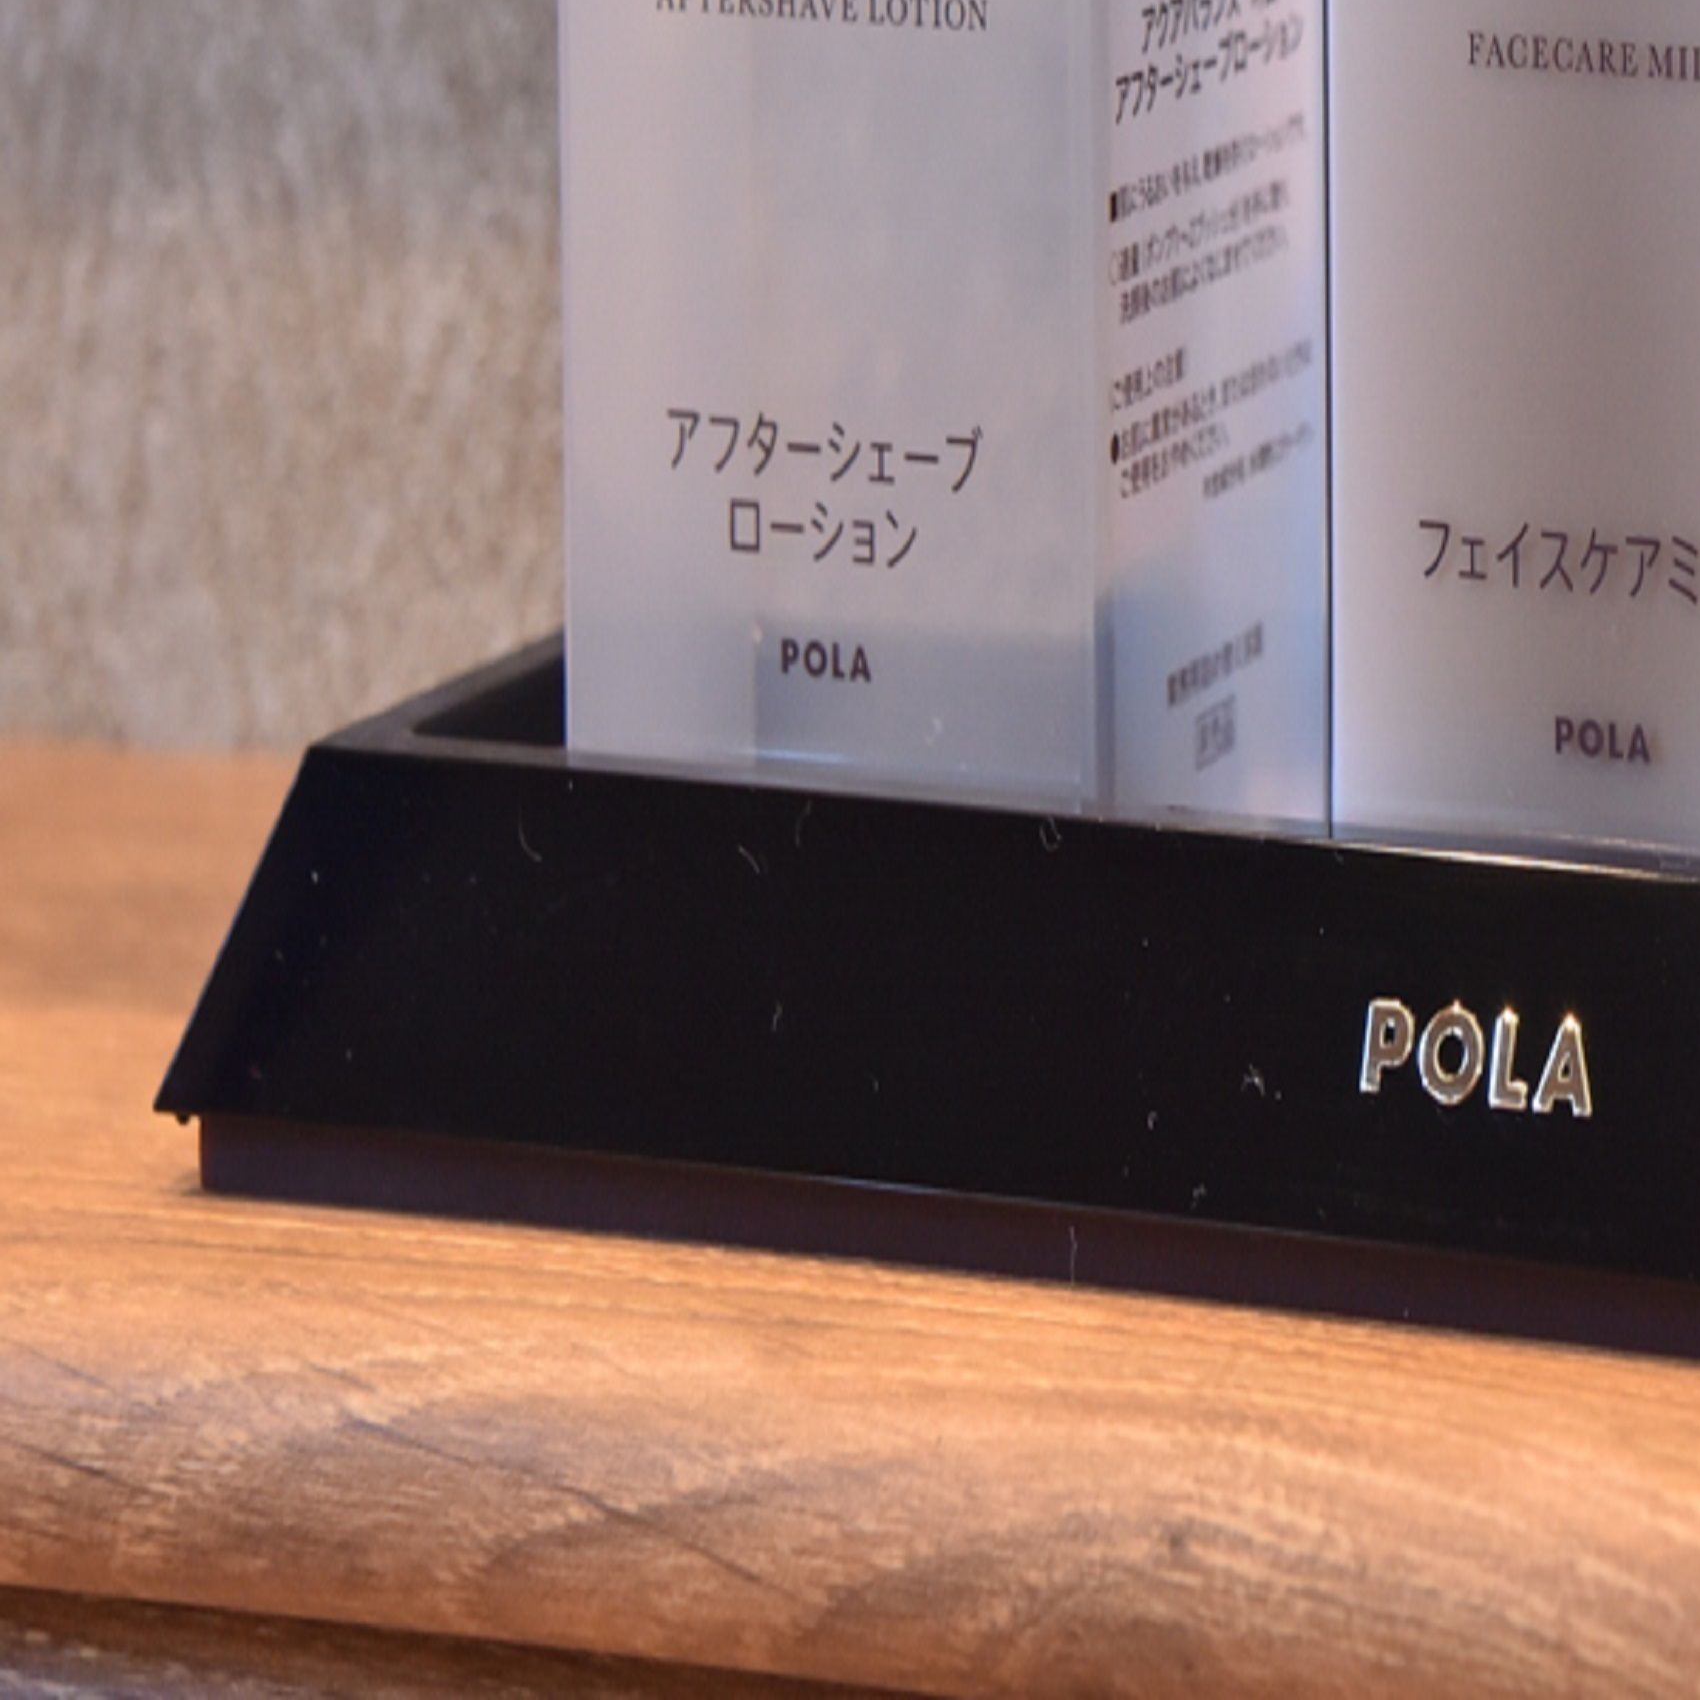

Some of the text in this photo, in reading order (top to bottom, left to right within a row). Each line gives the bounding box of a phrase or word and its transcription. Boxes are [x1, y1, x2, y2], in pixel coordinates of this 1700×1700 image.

[1115, 11, 1303, 126] アフターシェーブローション
[1468, 31, 1638, 78] FACECARE
[667, 409, 983, 493] アフターシェーブ
[730, 498, 916, 568] ローション
[781, 638, 872, 683] POLA
[1554, 716, 1652, 764] POLA
[1359, 998, 1593, 1118] POLA
